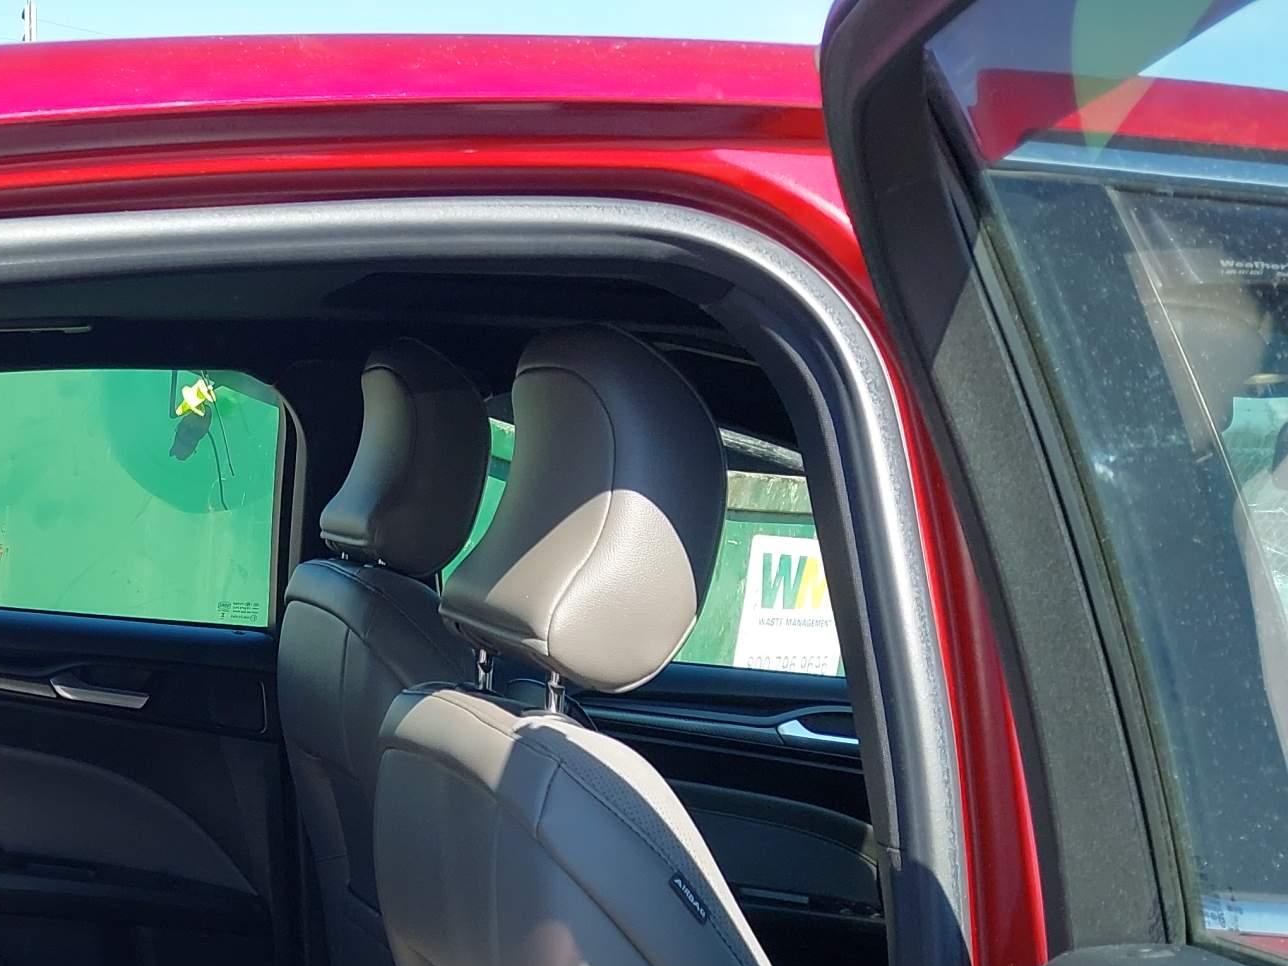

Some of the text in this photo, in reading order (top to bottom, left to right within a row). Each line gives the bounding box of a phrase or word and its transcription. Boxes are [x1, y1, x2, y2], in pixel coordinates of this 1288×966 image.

[758, 617, 833, 628] WASTE MANAGEMENT
[673, 878, 707, 919] AIRBAG
